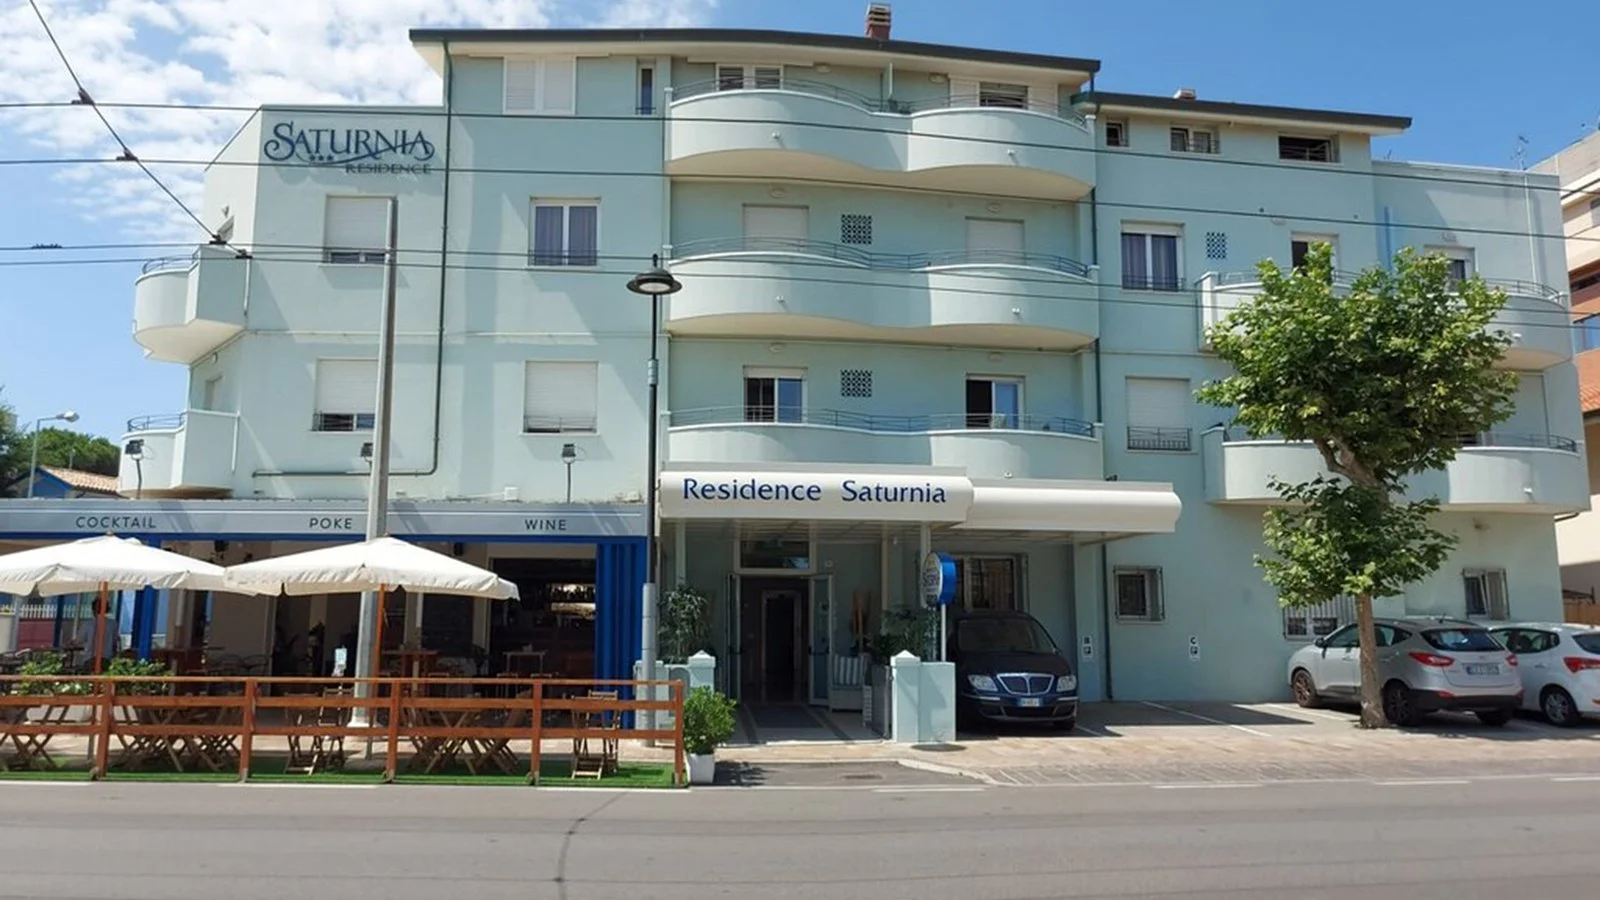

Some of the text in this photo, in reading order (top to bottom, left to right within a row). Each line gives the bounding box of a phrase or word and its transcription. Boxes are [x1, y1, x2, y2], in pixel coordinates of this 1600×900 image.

[264, 121, 436, 162] SATURNIA
[345, 163, 432, 175] RESIDENCE
[683, 478, 947, 503] Residence Saturnia
[75, 516, 157, 529] COCKTAIL
[309, 517, 353, 530] POKE
[524, 519, 567, 531] WINE
